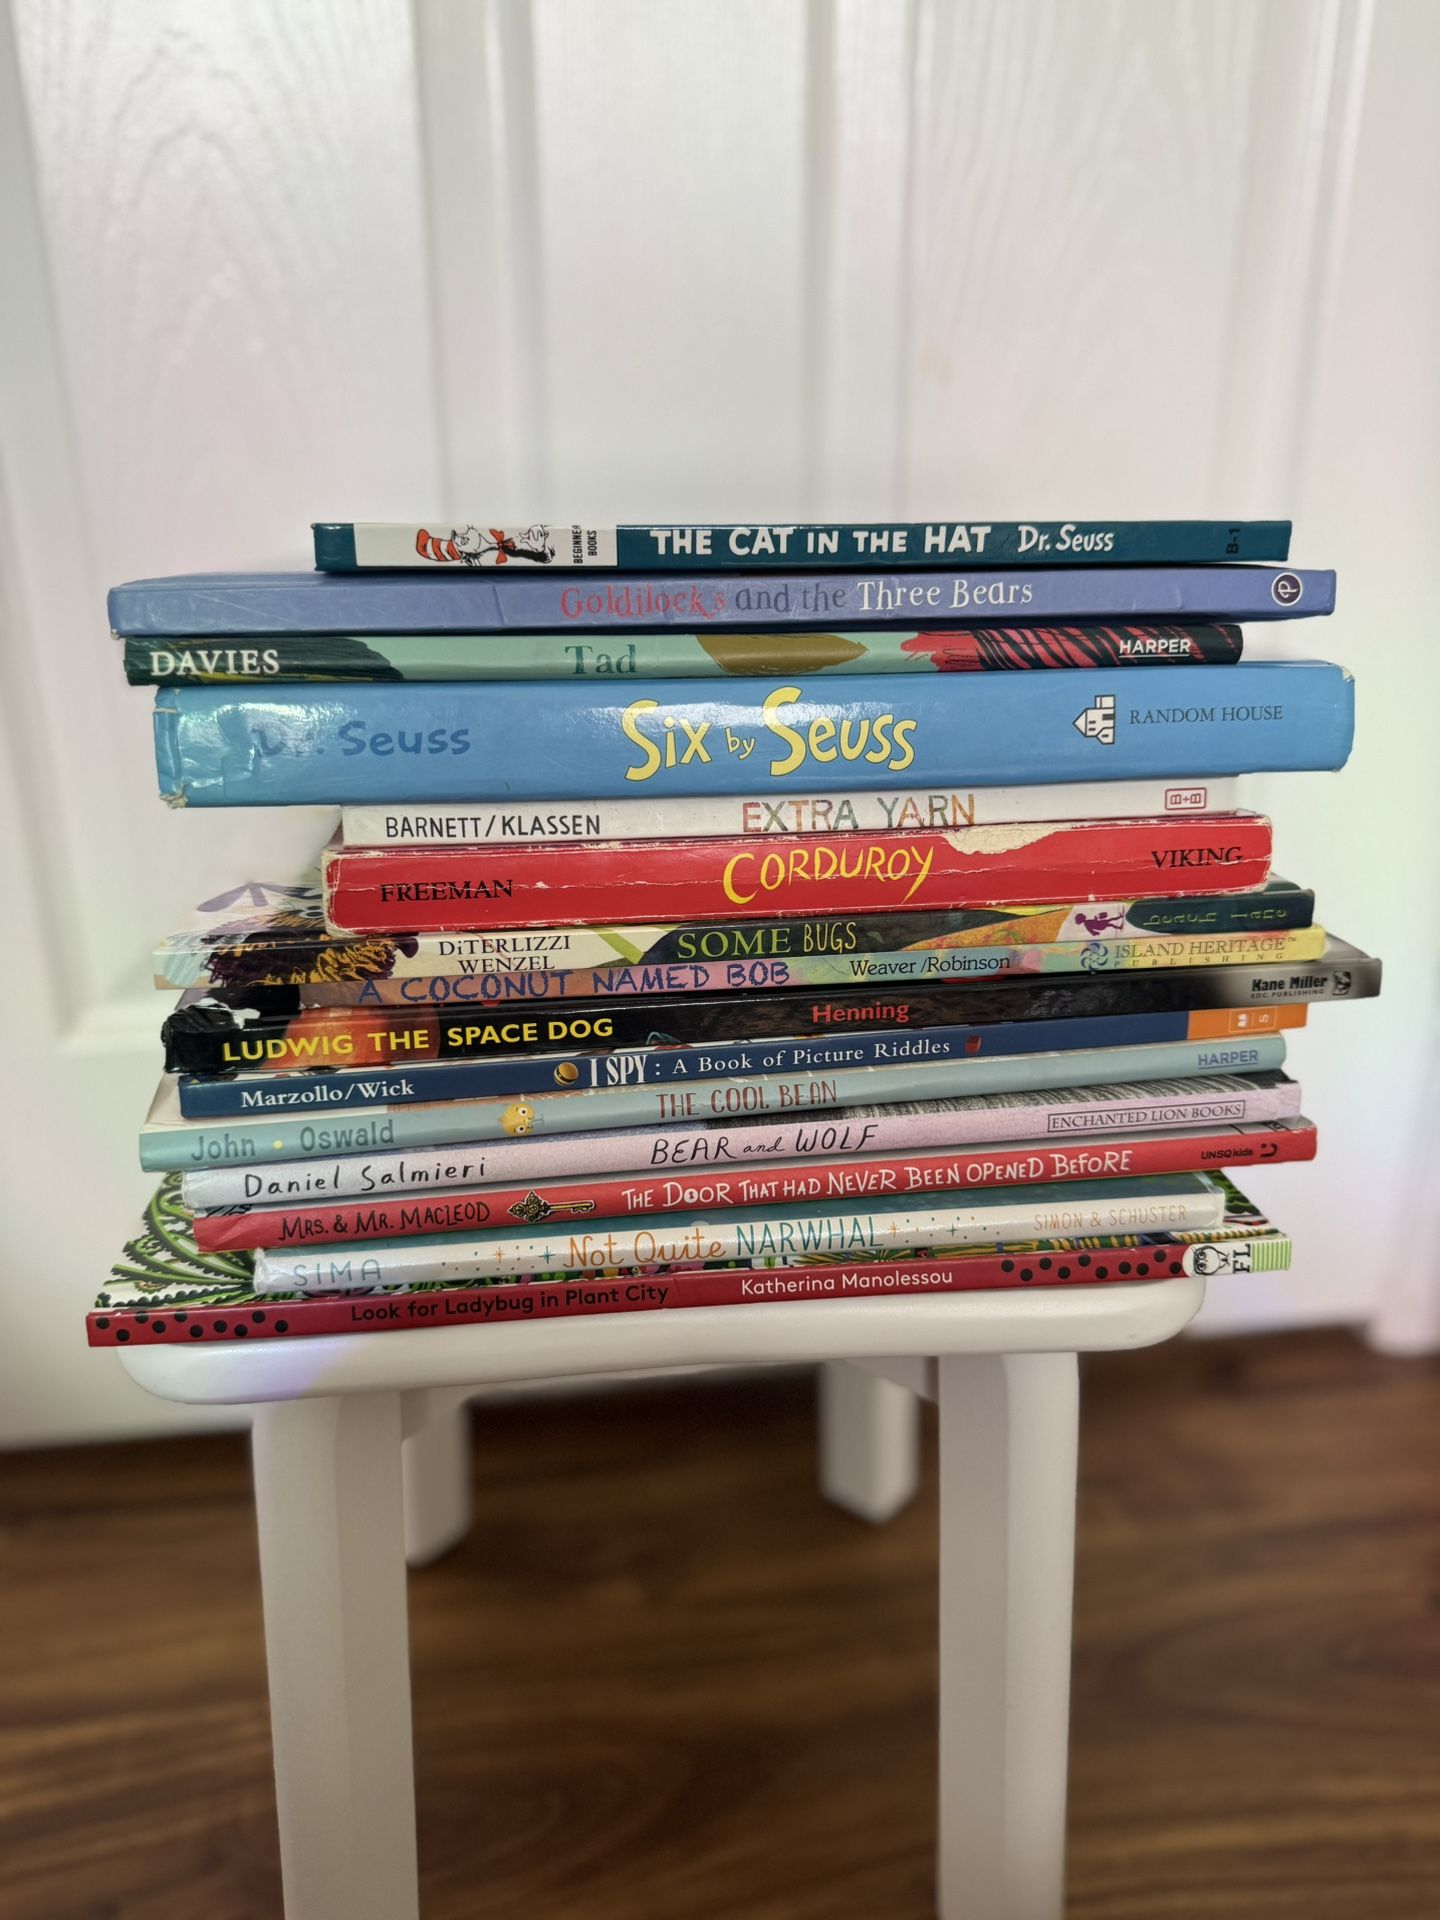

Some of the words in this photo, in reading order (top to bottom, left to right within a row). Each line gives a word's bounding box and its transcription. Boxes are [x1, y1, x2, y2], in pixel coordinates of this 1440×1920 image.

[572, 525, 583, 563] BEGINNER
[587, 530, 597, 556] BOOKS
[649, 529, 713, 556] THE
[728, 527, 794, 555] CAT
[807, 529, 839, 554] IN
[853, 529, 907, 554] THE
[924, 525, 993, 553] HAT
[1018, 526, 1051, 553] Dr.
[1055, 524, 1115, 552] Seuss
[560, 583, 726, 619] Goldilocks
[735, 583, 791, 612] and
[801, 583, 847, 612] the
[857, 581, 940, 610] Three
[948, 579, 1033, 609] Bears
[565, 643, 638, 675] Tad
[1119, 638, 1191, 654] HARPER
[151, 649, 280, 677] DAVIES
[1129, 707, 1216, 725] RANDOM
[1222, 705, 1284, 723] HOUSE
[339, 720, 472, 757] Seuss
[621, 698, 714, 782] Six
[725, 726, 757, 761] by
[762, 685, 918, 777] Seuss
[386, 814, 601, 839] BARNETT/KLASSEN
[742, 799, 860, 834] EXTRA
[877, 793, 976, 829] YARN
[1151, 845, 1245, 869] VIKING
[722, 845, 935, 905] CORDUROY
[380, 878, 514, 902] FREEMAN
[1143, 912, 1218, 926] beach
[1231, 908, 1288, 919] lane
[439, 935, 572, 956] DiTERLIZZI
[677, 927, 792, 960] SOME
[804, 921, 857, 955] BUGS
[1114, 942, 1185, 959] ISLAND
[458, 955, 556, 974] WENZEL
[1114, 952, 1284, 968] PUBLISHING
[358, 979, 383, 1004] A
[401, 969, 575, 1002] COCONUT
[592, 964, 710, 994] NAMED
[727, 961, 790, 988] BOB
[1251, 979, 1285, 992] Kane
[1290, 976, 1328, 989] Miller
[1271, 989, 1325, 998] PUBLISHING
[812, 1002, 910, 1025] Henning
[223, 1034, 353, 1062] LUDWIG
[368, 1029, 430, 1052] THE
[448, 1022, 538, 1047] SPACE
[548, 1018, 614, 1040] DOG
[589, 1058, 600, 1088] I
[672, 1059, 688, 1075] A
[699, 1056, 753, 1073] Book
[763, 1051, 787, 1068] of
[793, 1047, 864, 1065] Picture
[874, 1040, 950, 1058] Riddles
[1198, 1050, 1259, 1067] HARPER
[240, 1079, 415, 1108] Marzollo/Wick
[656, 1092, 701, 1119] THE
[711, 1085, 770, 1114] COOL
[779, 1080, 837, 1108] BEAN
[1052, 1109, 1148, 1129] ENCHANTED
[1151, 1108, 1188, 1122] LION
[1192, 1103, 1242, 1119] BOOKS
[191, 1132, 257, 1162] John
[300, 1119, 395, 1152] Oswald
[651, 1136, 737, 1165] BEAR
[743, 1136, 786, 1154] and
[795, 1124, 879, 1151] WOLF
[245, 1165, 340, 1198] Daniel
[361, 1157, 486, 1192] Salmieri
[622, 1189, 654, 1211] THE
[663, 1181, 733, 1206] DOOR
[739, 1179, 781, 1201] THAT
[782, 1176, 820, 1195] HAD
[827, 1169, 897, 1195] NEVER
[904, 1163, 961, 1190] BEEN
[966, 1157, 1043, 1183] OPENED
[333, 1214, 348, 1233] &
[1034, 1211, 1083, 1231] SIMON
[1090, 1210, 1102, 1227] &
[1109, 1204, 1187, 1226] SCHUSTER
[563, 1234, 625, 1268] Not
[634, 1226, 726, 1264] Quite
[736, 1216, 883, 1257] NARWHAL
[293, 1258, 382, 1287] SIMA
[741, 1275, 836, 1295] Katherina
[842, 1269, 953, 1291] Manolessou
[351, 1303, 401, 1321] Look
[408, 1300, 438, 1318] for
[446, 1294, 534, 1317] Ladybug
[540, 1290, 559, 1308] in
[565, 1287, 619, 1306] Plant
[625, 1283, 669, 1304] City
